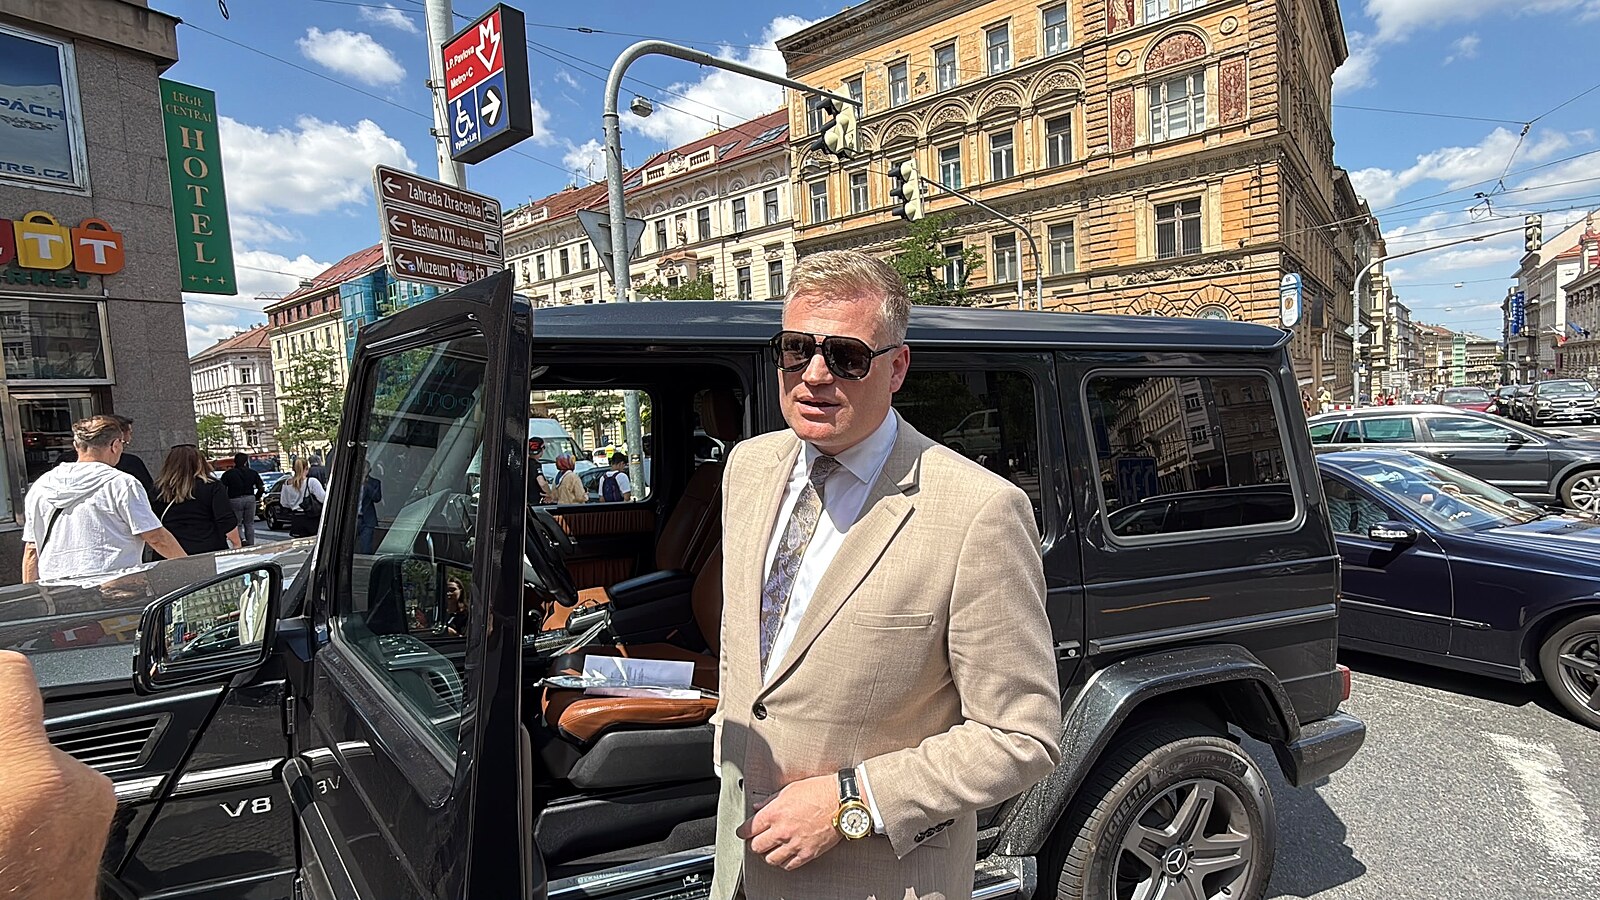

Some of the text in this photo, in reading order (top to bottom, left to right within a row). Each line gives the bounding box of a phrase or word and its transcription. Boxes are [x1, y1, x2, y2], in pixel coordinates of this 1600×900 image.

[172, 91, 204, 107] LEGIE
[165, 104, 213, 123] CENTRAL
[179, 125, 216, 264] HOTEL
[407, 182, 482, 218] Zahrada Ztracenka
[411, 218, 439, 241] Bastion
[438, 226, 456, 245] XXXI
[415, 256, 450, 278] Muzeum
[475, 264, 486, 281] ČR
[219, 795, 273, 818] V8
